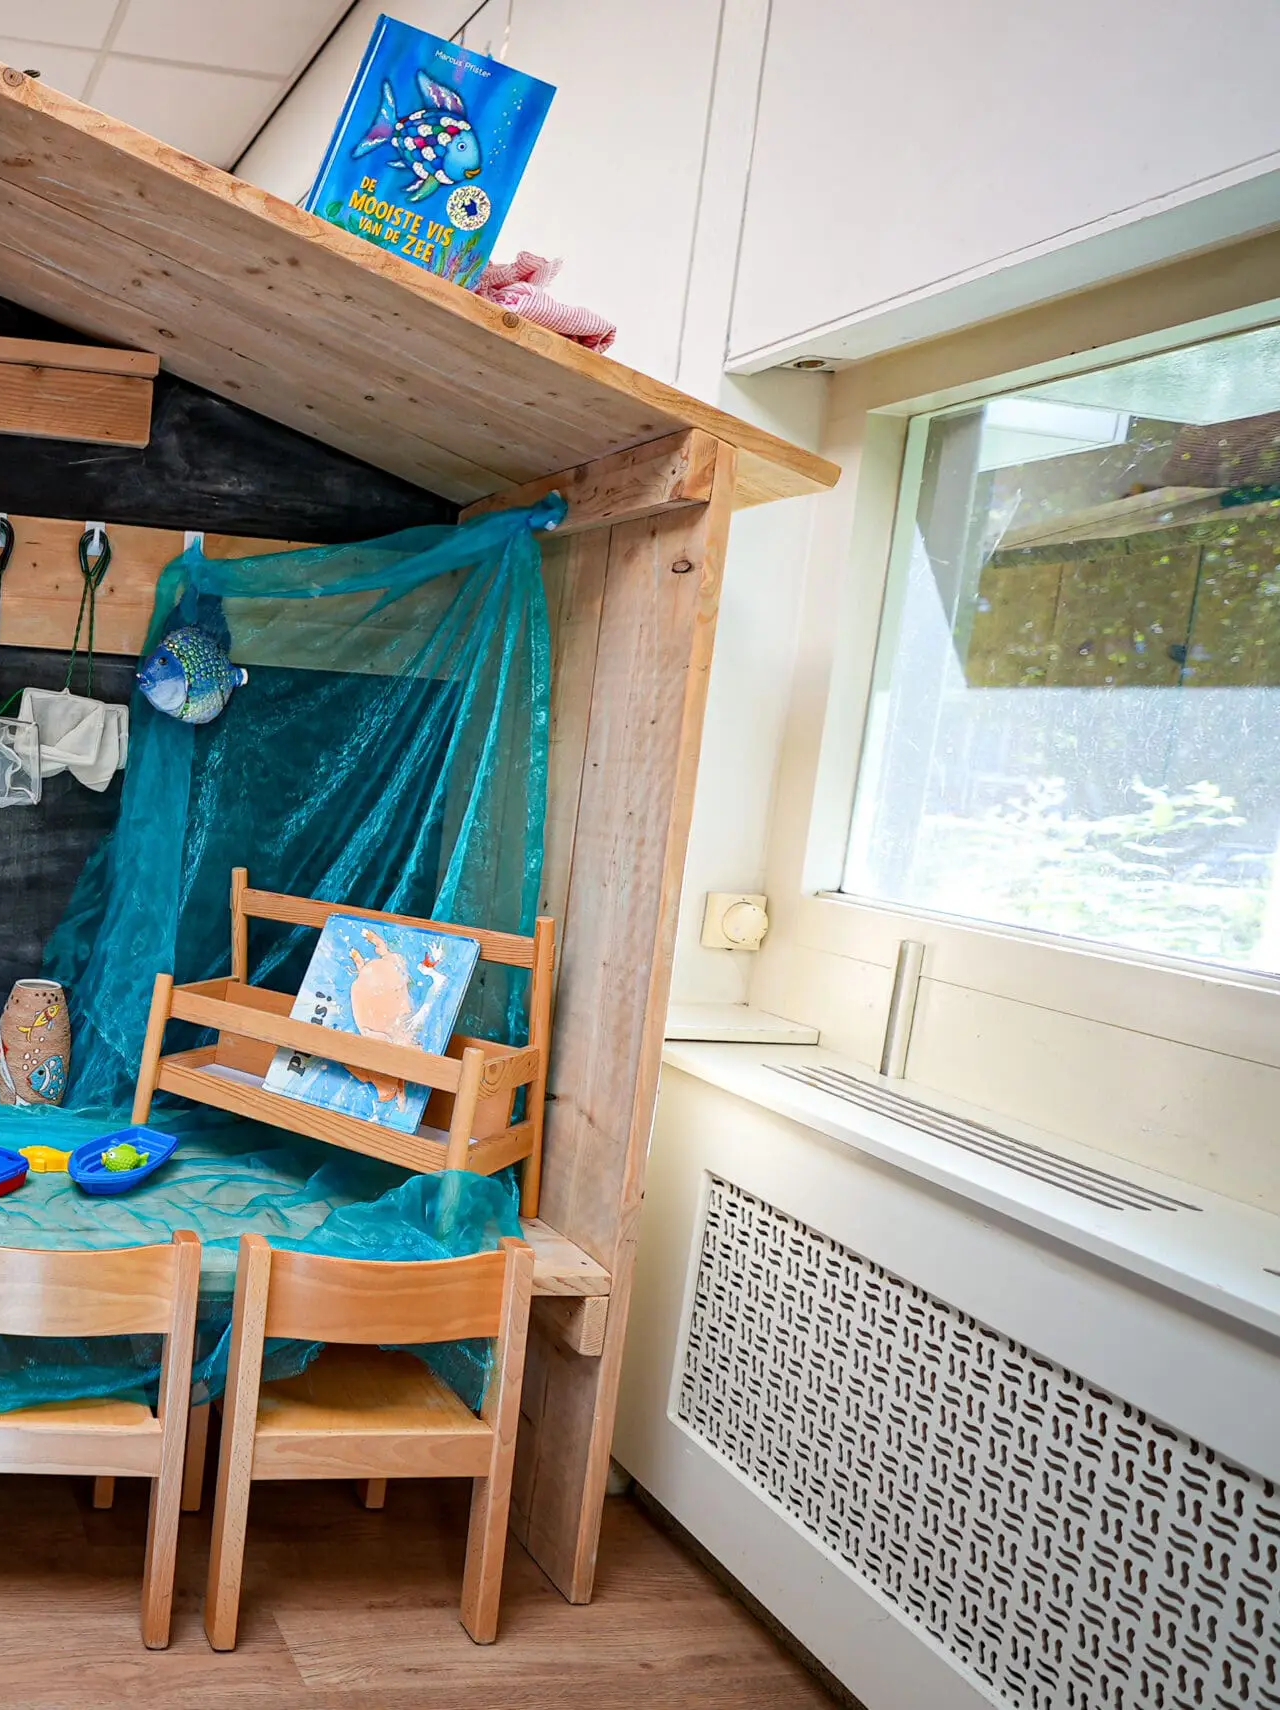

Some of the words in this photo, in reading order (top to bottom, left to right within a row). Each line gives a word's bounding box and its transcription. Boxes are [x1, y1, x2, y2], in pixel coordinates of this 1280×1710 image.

[434, 49, 463, 67] Marcus
[464, 61, 492, 78] Pfister
[360, 175, 378, 193] DE
[349, 189, 424, 235] MOOISTE
[427, 220, 455, 247] VIS
[358, 216, 383, 237] VAN
[384, 226, 401, 244] DE
[401, 234, 436, 263] ZEE
